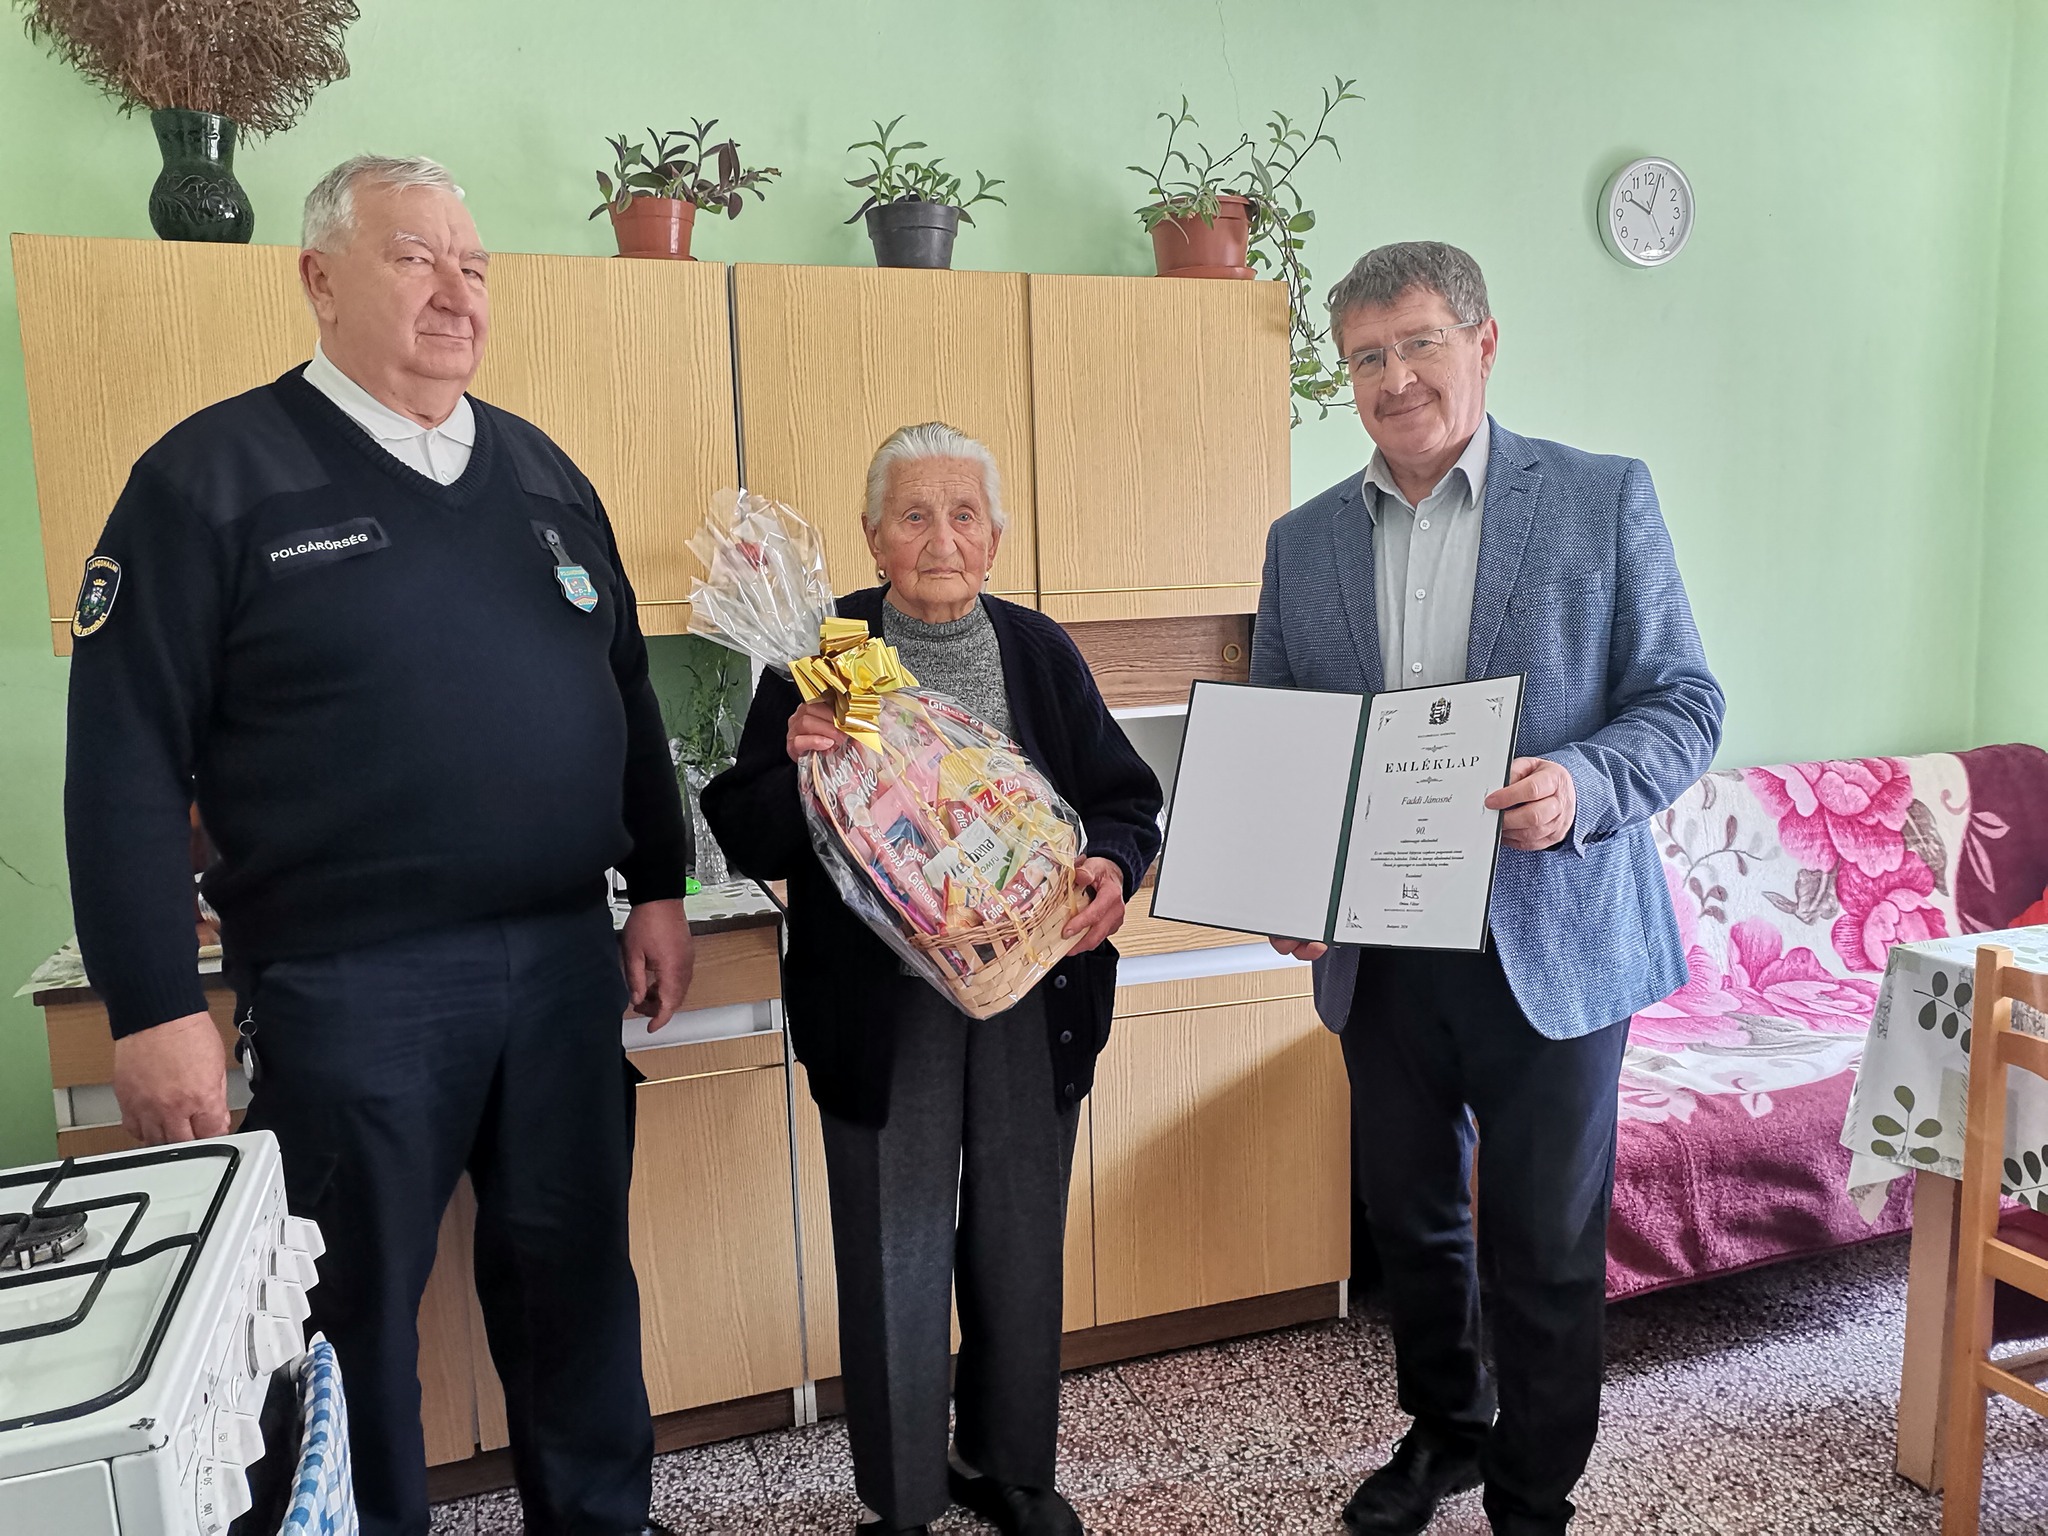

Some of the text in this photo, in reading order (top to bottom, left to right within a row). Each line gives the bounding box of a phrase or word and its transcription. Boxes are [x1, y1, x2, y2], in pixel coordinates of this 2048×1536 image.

[1632, 177, 1639, 189] 11
[1644, 172, 1655, 186] 12
[1620, 189, 1633, 203] 10
[1670, 188, 1677, 201] 2
[1616, 208, 1624, 220] 9
[1673, 207, 1680, 219] 3
[1621, 226, 1628, 238] 8
[1669, 226, 1675, 237] 4
[1633, 239, 1639, 250] 7
[1660, 237, 1665, 249] 5
[270, 533, 369, 562] POLGÁRŐRSÉG
[1384, 755, 1480, 774] EMLÉKLAP
[1400, 793, 1453, 806] Faddi Jánosné
[908, 871, 938, 909] Cafetero
[982, 894, 1018, 921] Cafeero
